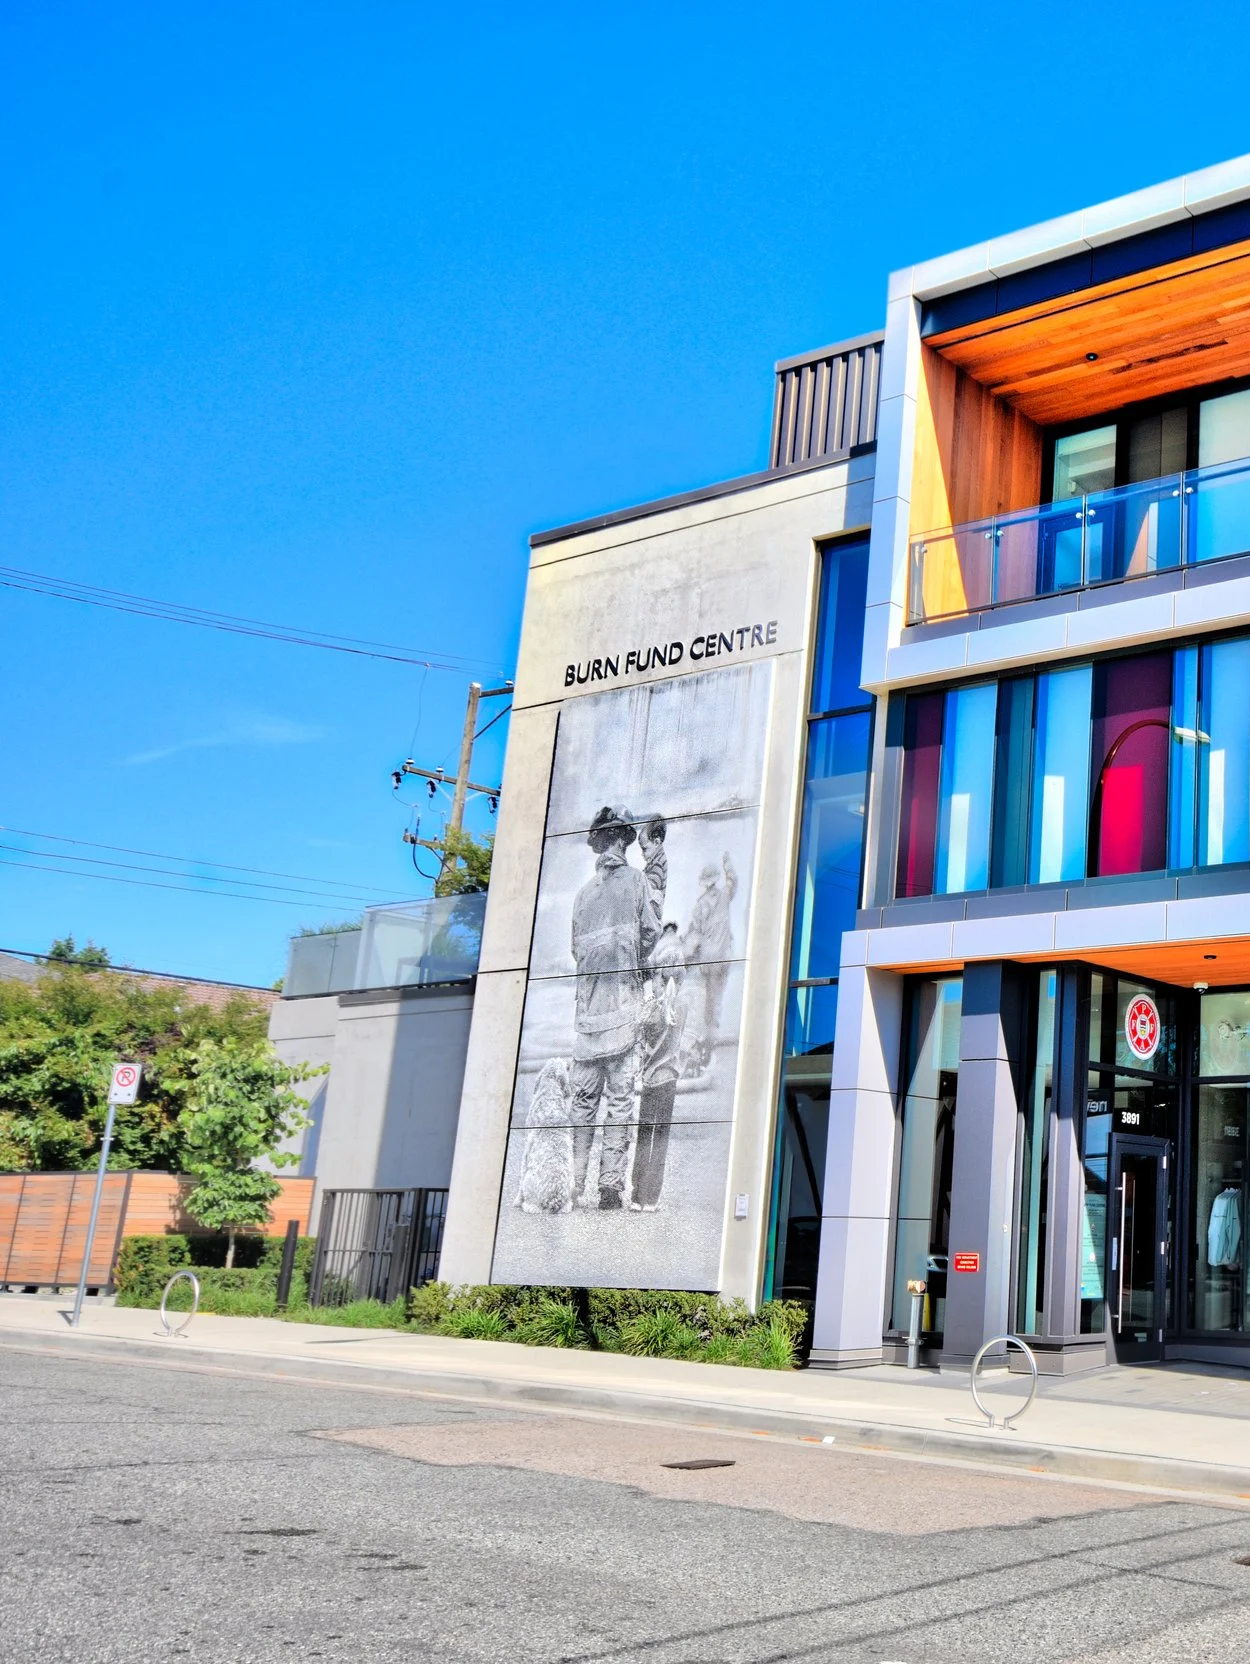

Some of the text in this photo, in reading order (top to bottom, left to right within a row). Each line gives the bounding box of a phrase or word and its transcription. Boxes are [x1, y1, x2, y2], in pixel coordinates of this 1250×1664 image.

[564, 620, 779, 687] BURN FUND CENTRE
[1121, 1111, 1140, 1125] 3891
